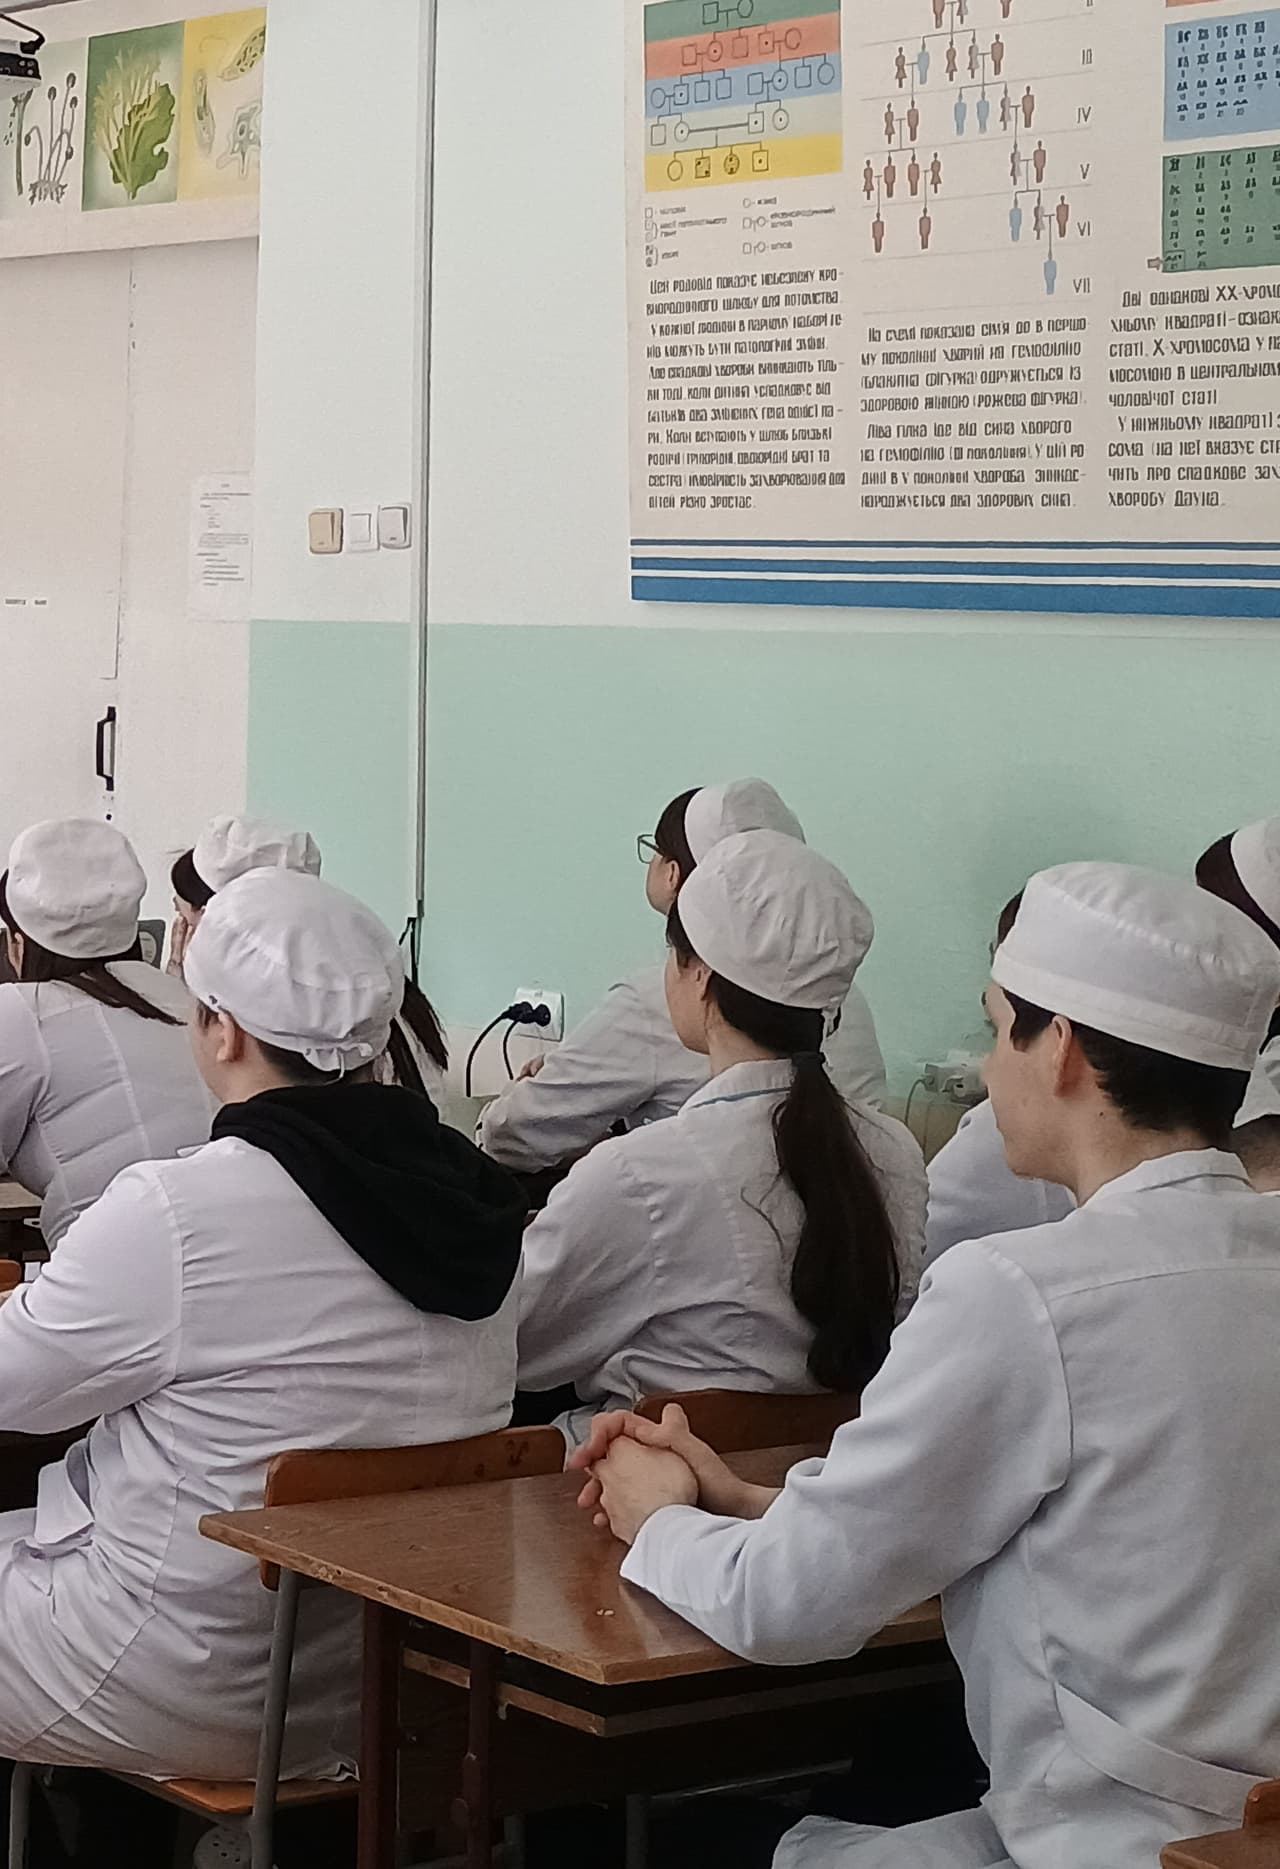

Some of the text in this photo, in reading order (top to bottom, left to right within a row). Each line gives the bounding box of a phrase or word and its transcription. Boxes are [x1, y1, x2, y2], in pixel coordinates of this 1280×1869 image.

[1077, 106, 1091, 124] IV
[1080, 163, 1090, 180] V
[1077, 222, 1090, 237] VI
[1073, 279, 1090, 294] VII
